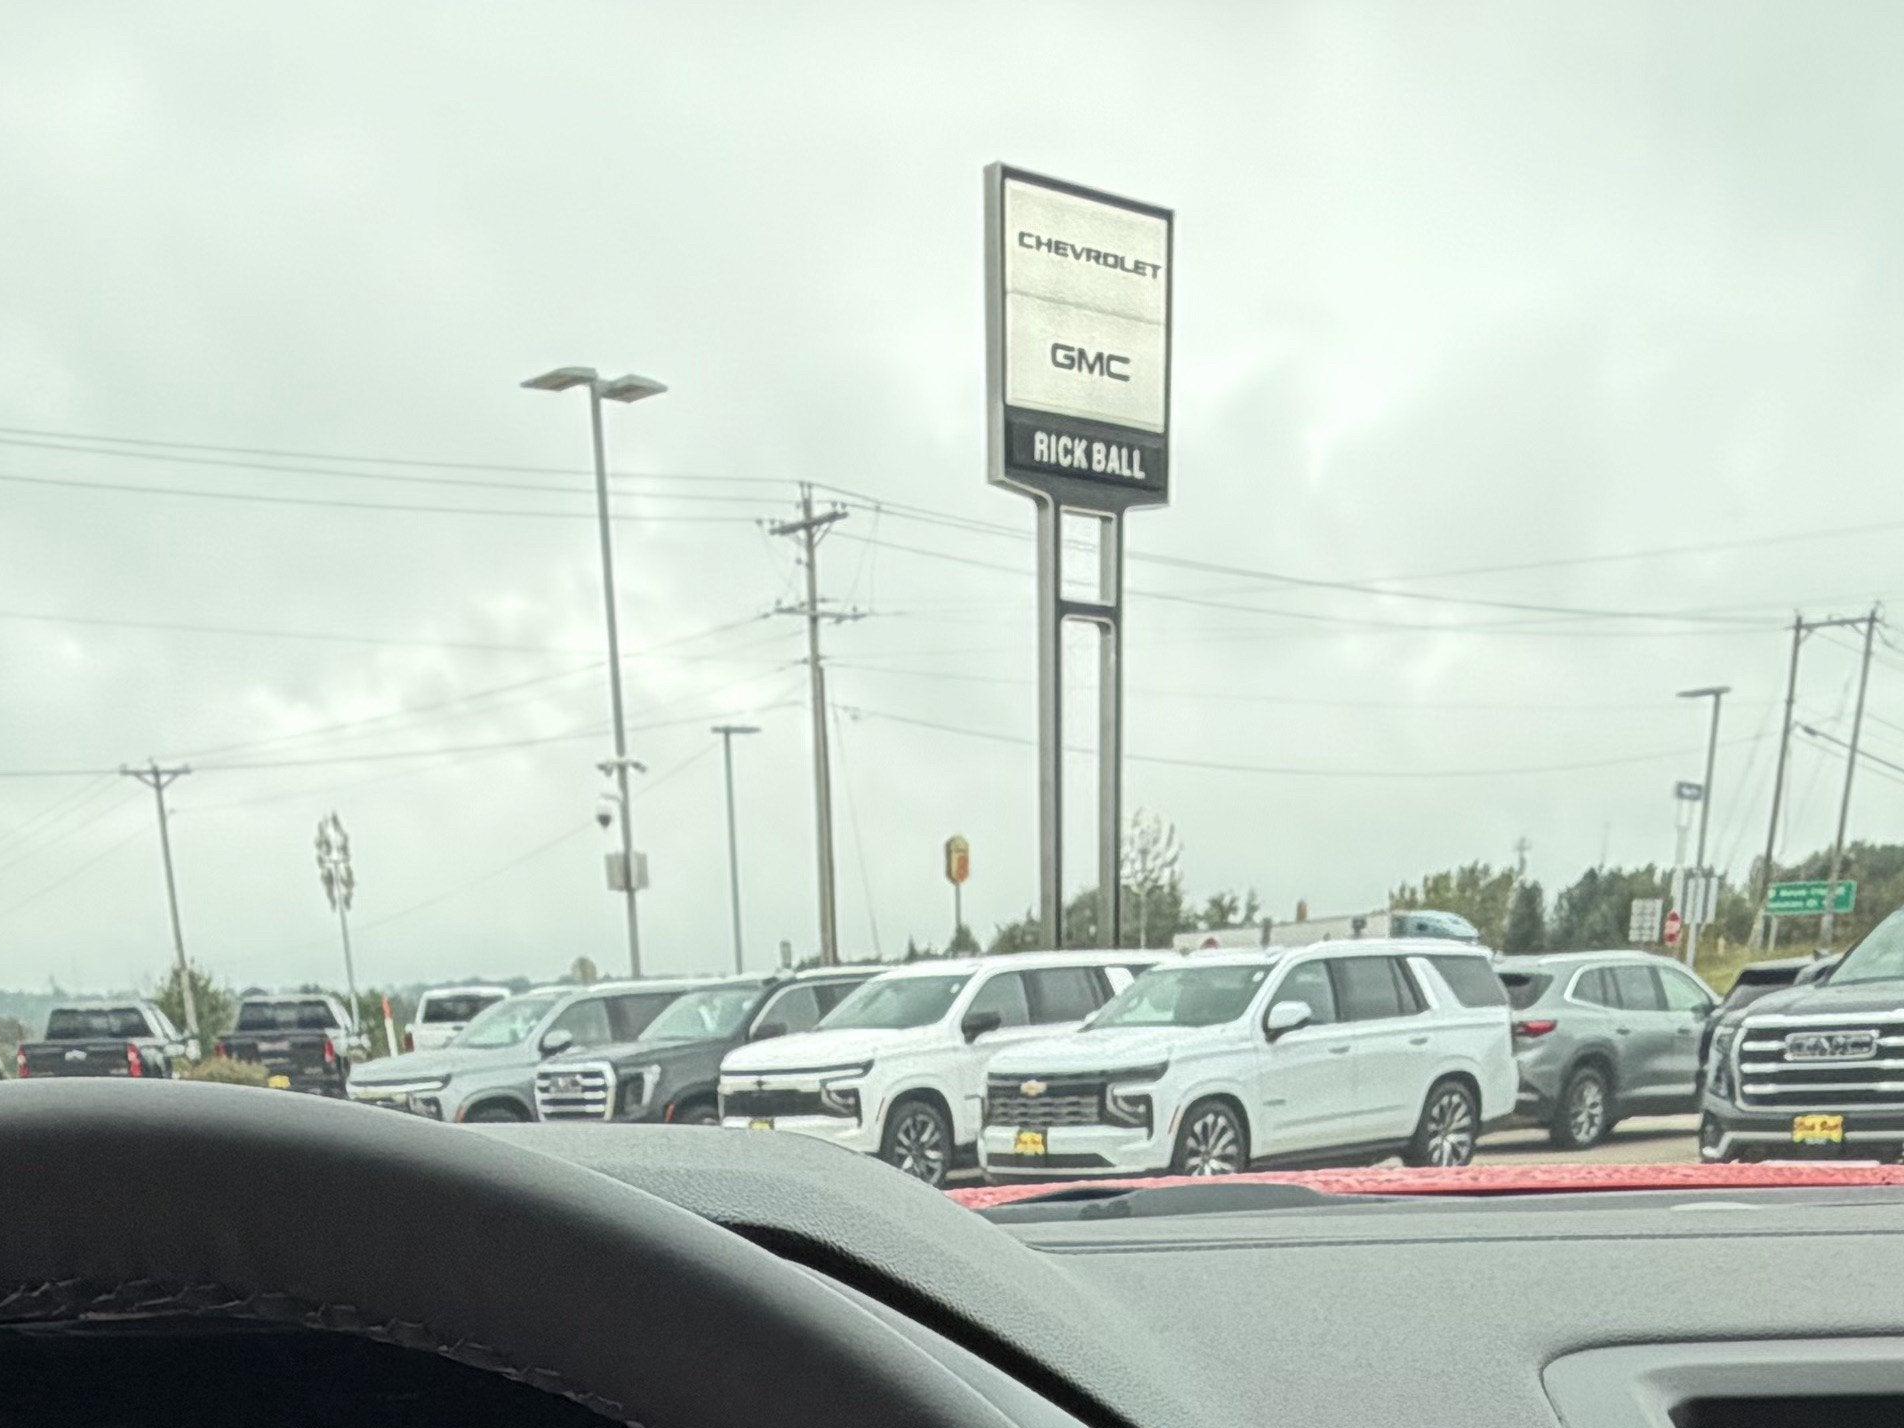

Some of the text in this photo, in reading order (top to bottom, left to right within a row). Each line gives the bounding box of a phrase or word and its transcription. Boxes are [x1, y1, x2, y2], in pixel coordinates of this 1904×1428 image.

[1017, 230, 1162, 279] CHEVROLET
[1050, 342, 1131, 382] GMC
[1033, 430, 1147, 480] RICK BALL
